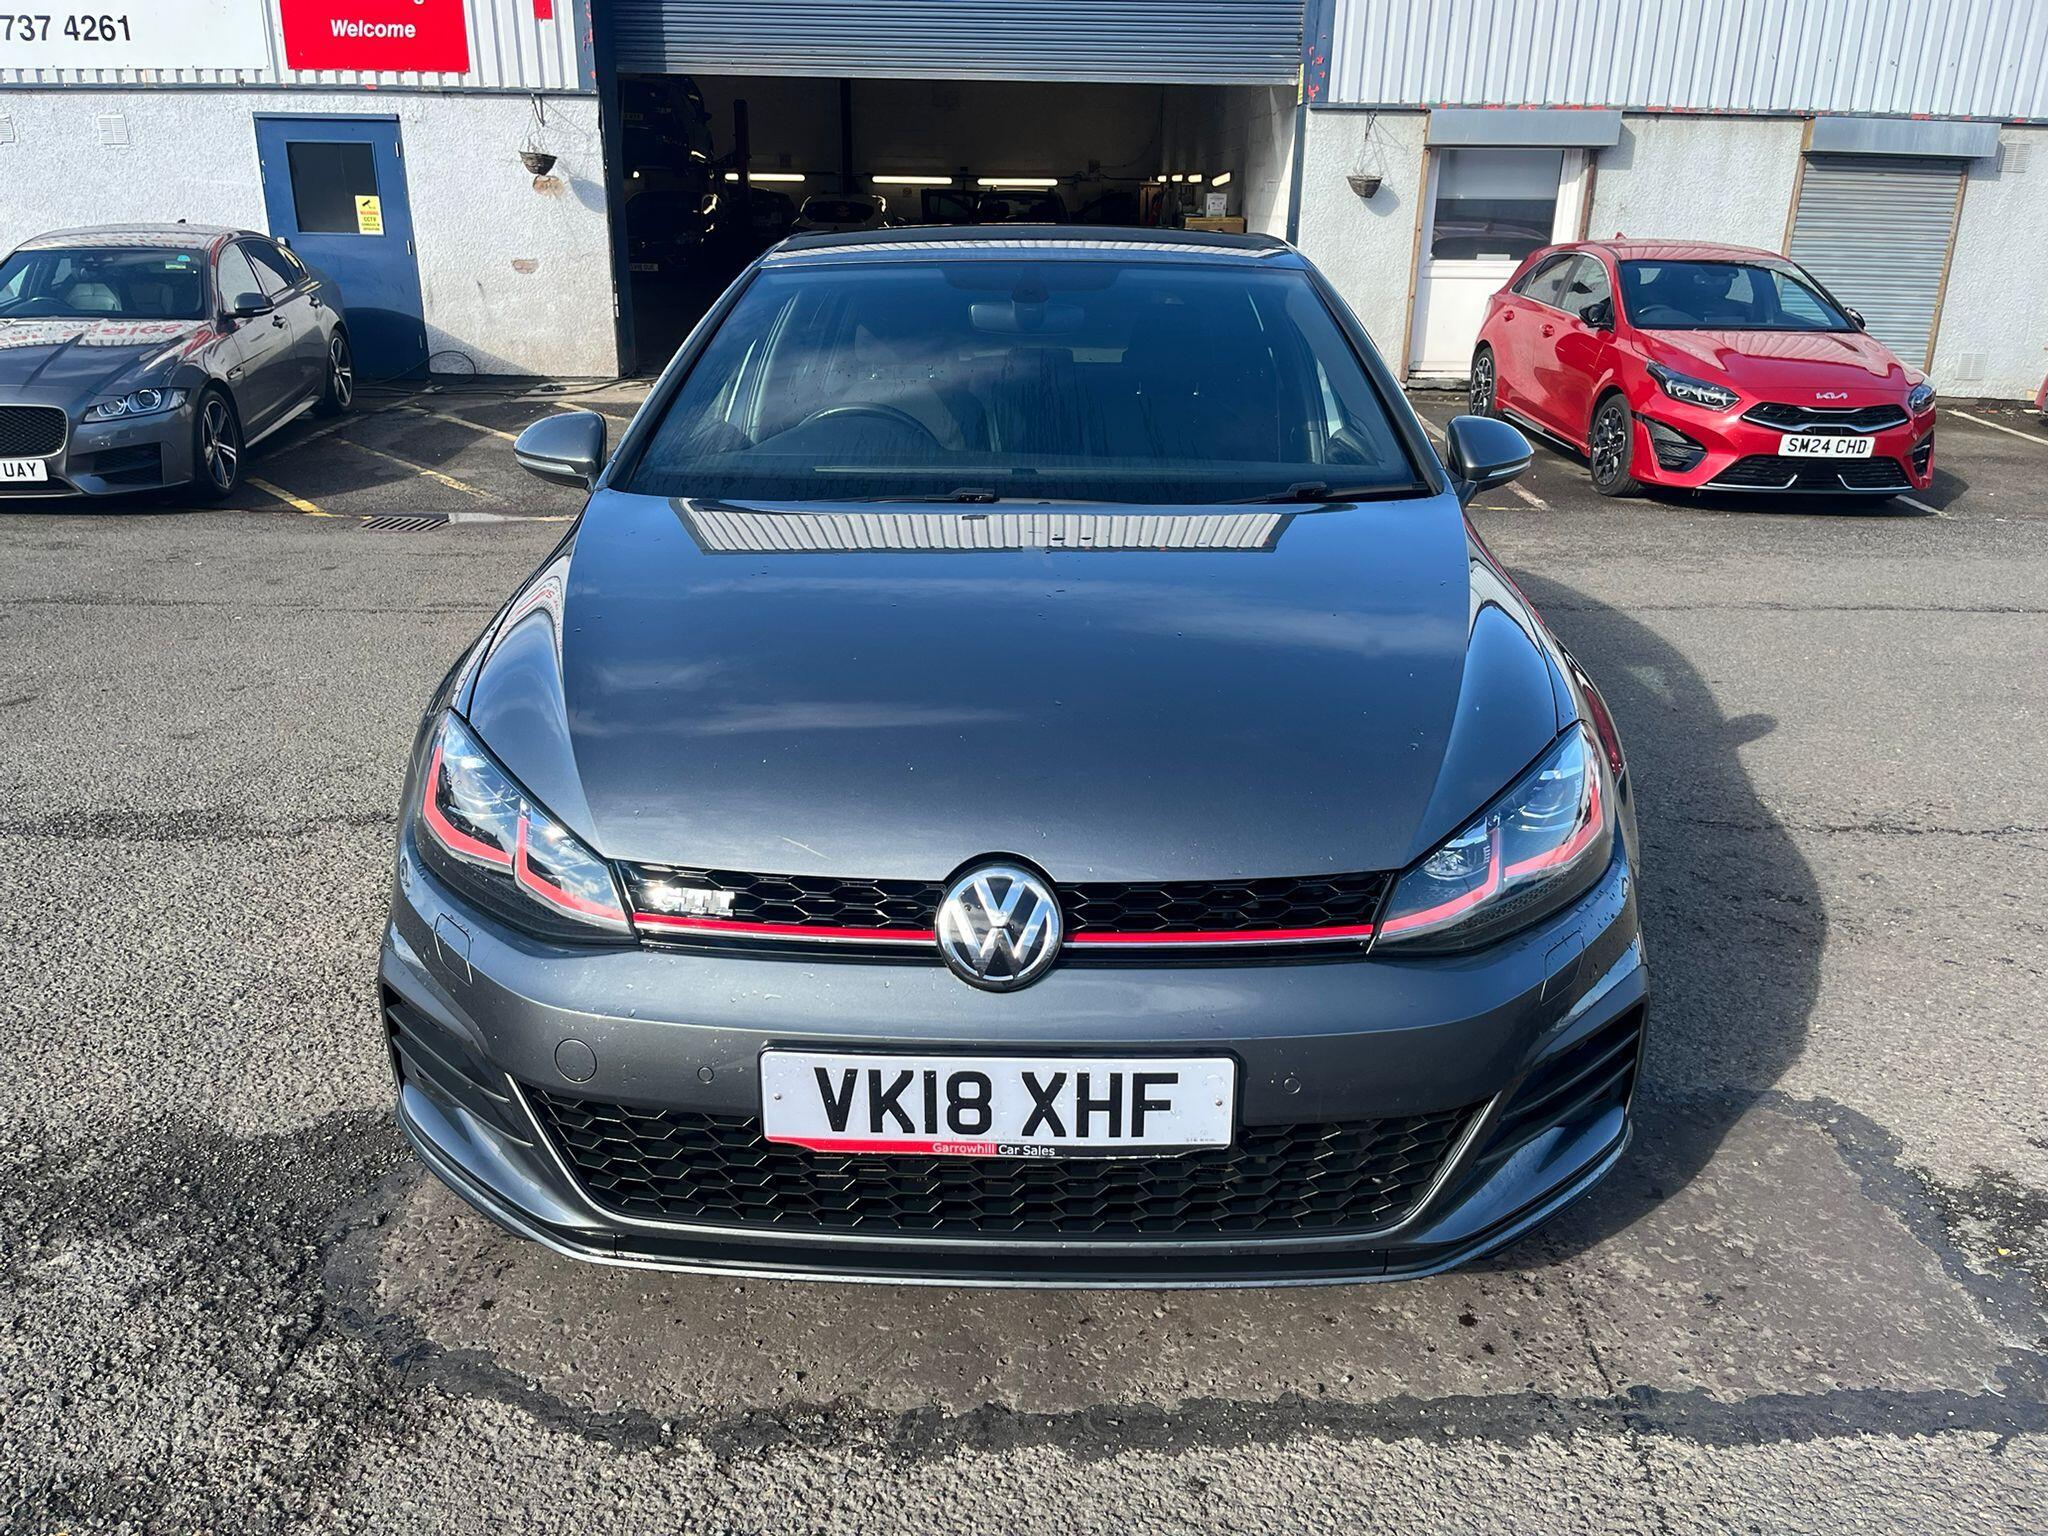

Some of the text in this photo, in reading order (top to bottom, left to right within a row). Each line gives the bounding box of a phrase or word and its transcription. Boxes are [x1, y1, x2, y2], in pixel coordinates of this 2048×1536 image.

[0, 15, 131, 41] 737 4261
[330, 19, 417, 38] Welcome
[1787, 437, 1868, 454] SM24 CHD
[3, 462, 37, 477] UAY
[813, 1066, 1179, 1138] VK18 XHF
[932, 1142, 1056, 1157] Garrowhill Car Sales
